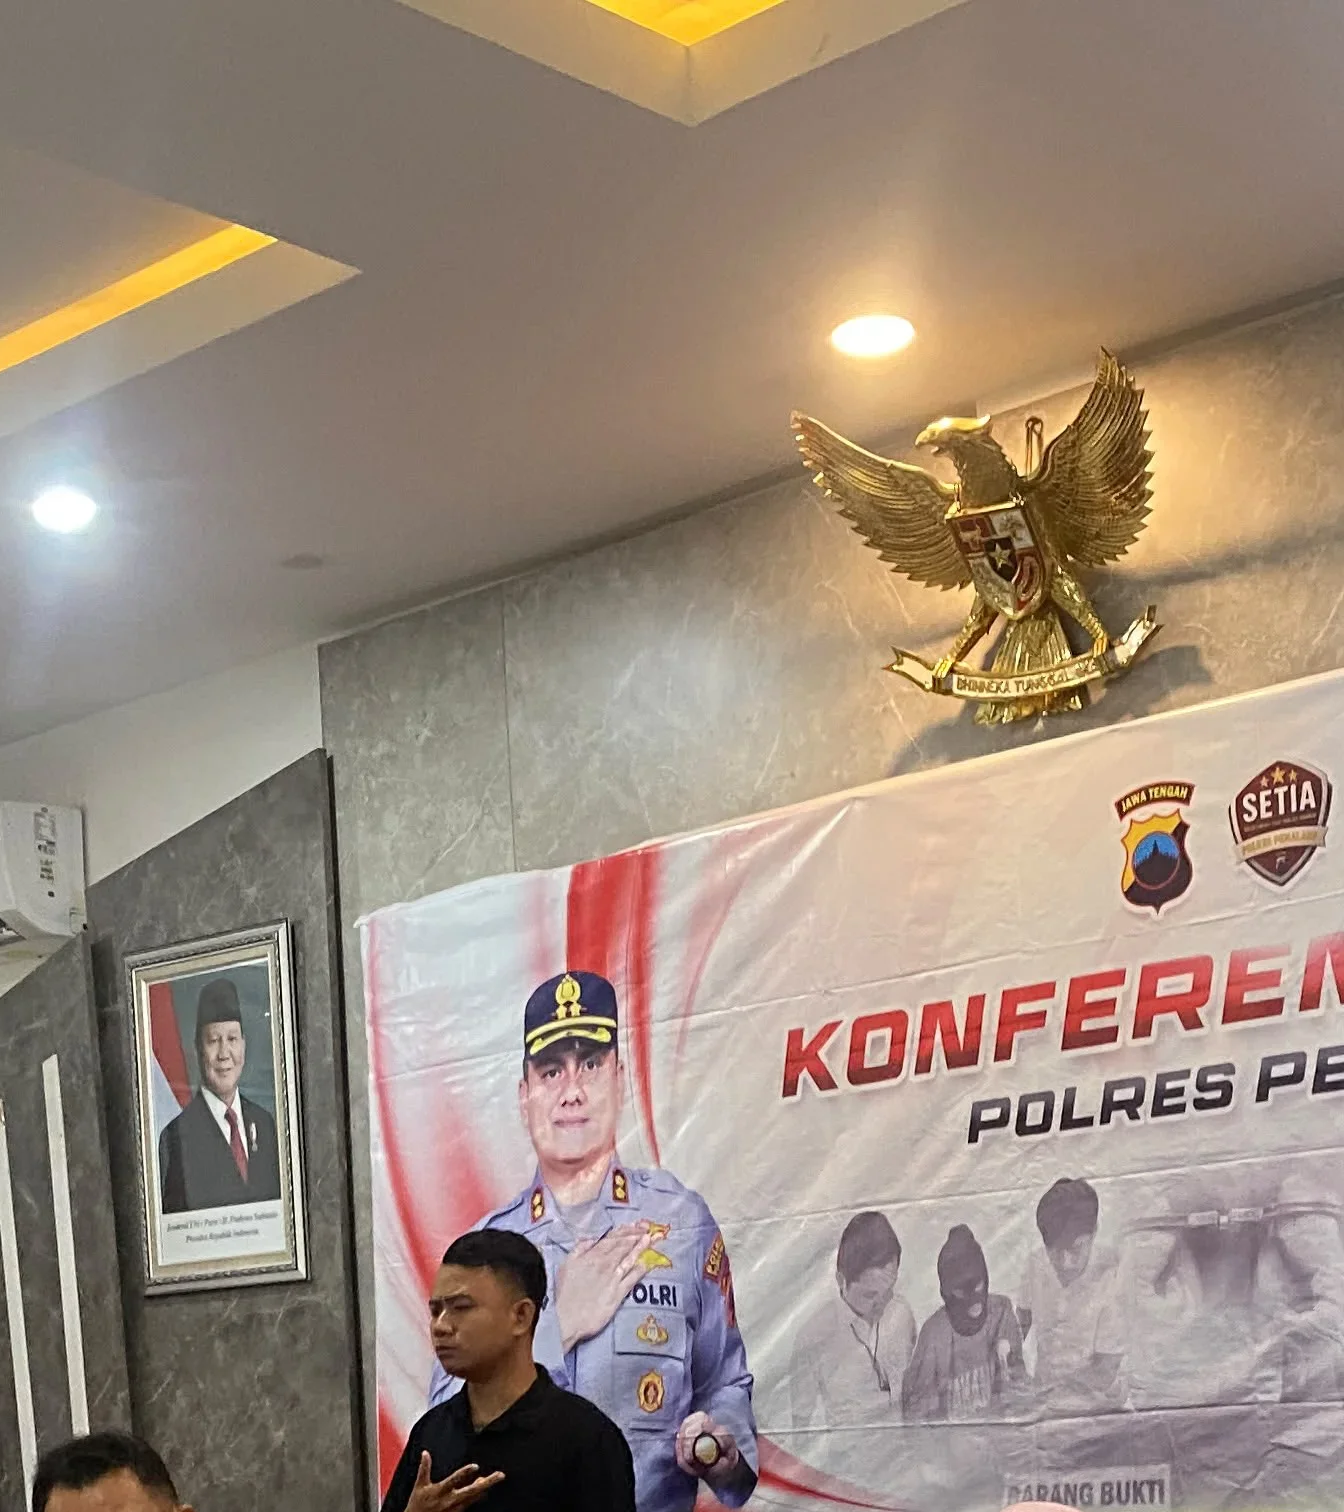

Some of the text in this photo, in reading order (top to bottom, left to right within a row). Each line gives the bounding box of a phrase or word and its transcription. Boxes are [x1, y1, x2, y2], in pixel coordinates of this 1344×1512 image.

[1121, 785, 1188, 812] JAWA TENGAH
[1242, 780, 1316, 823] SETIA
[966, 1062, 1236, 1144] POLRES
[625, 1283, 677, 1307] OLRI
[1100, 1478, 1165, 1506] BUKTI
